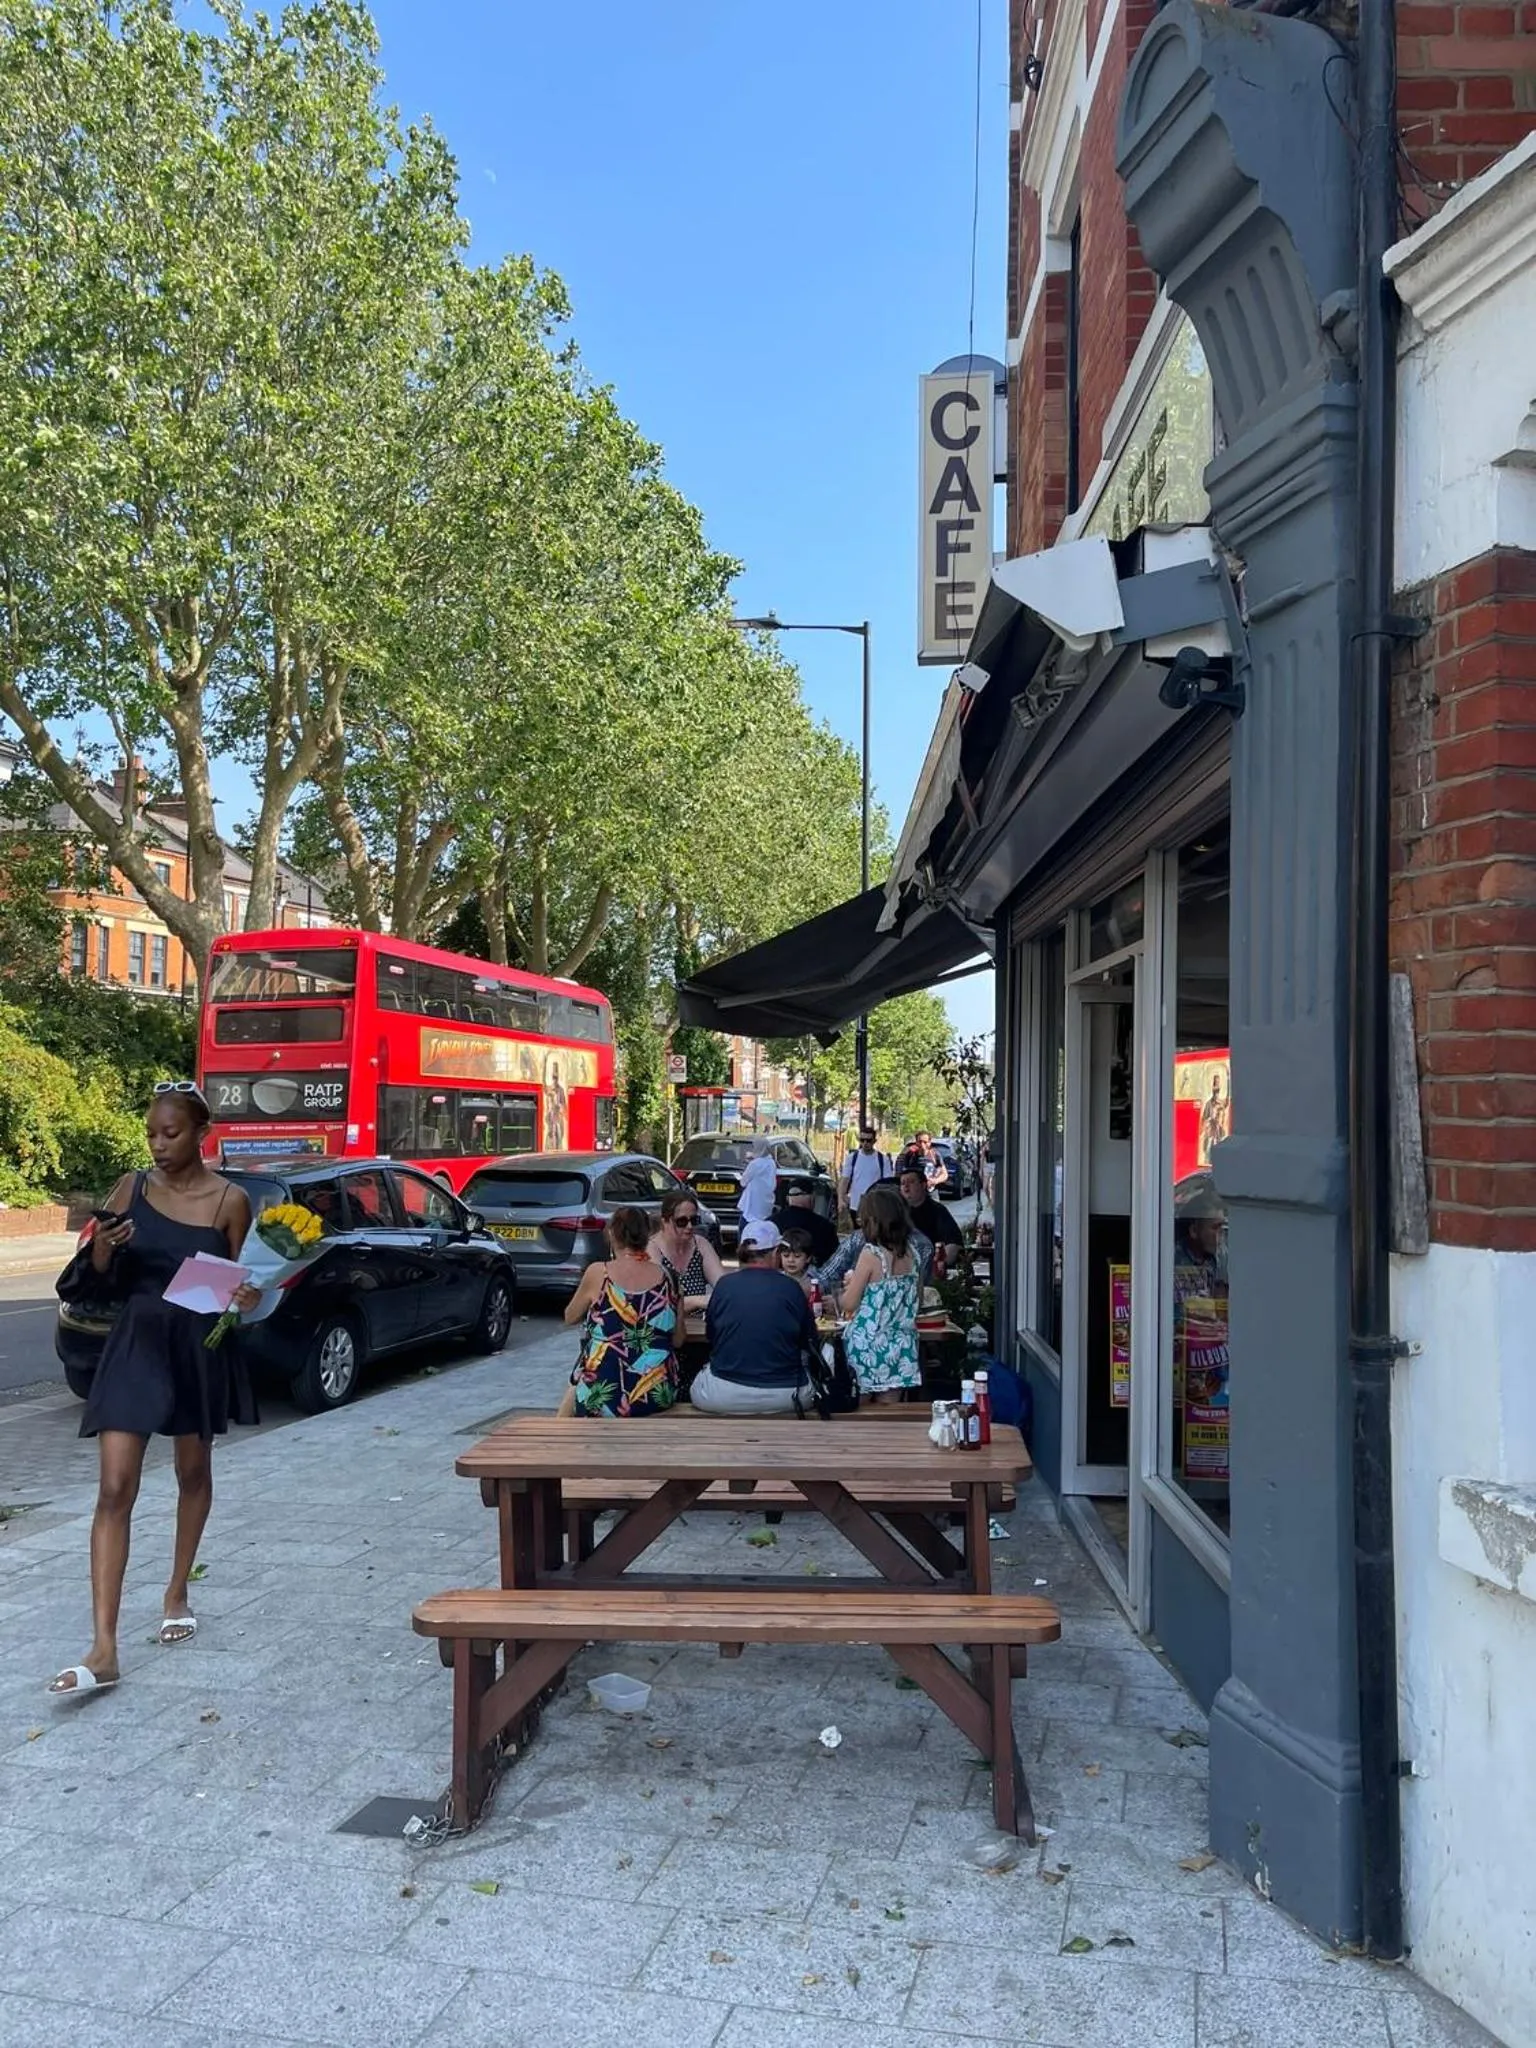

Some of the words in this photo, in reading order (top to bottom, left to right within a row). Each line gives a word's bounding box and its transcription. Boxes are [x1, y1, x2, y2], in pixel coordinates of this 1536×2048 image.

[929, 391, 981, 641] CAFE
[219, 1085, 242, 1105] 28
[304, 1083, 343, 1096] RATP
[304, 1097, 343, 1107] GROUP
